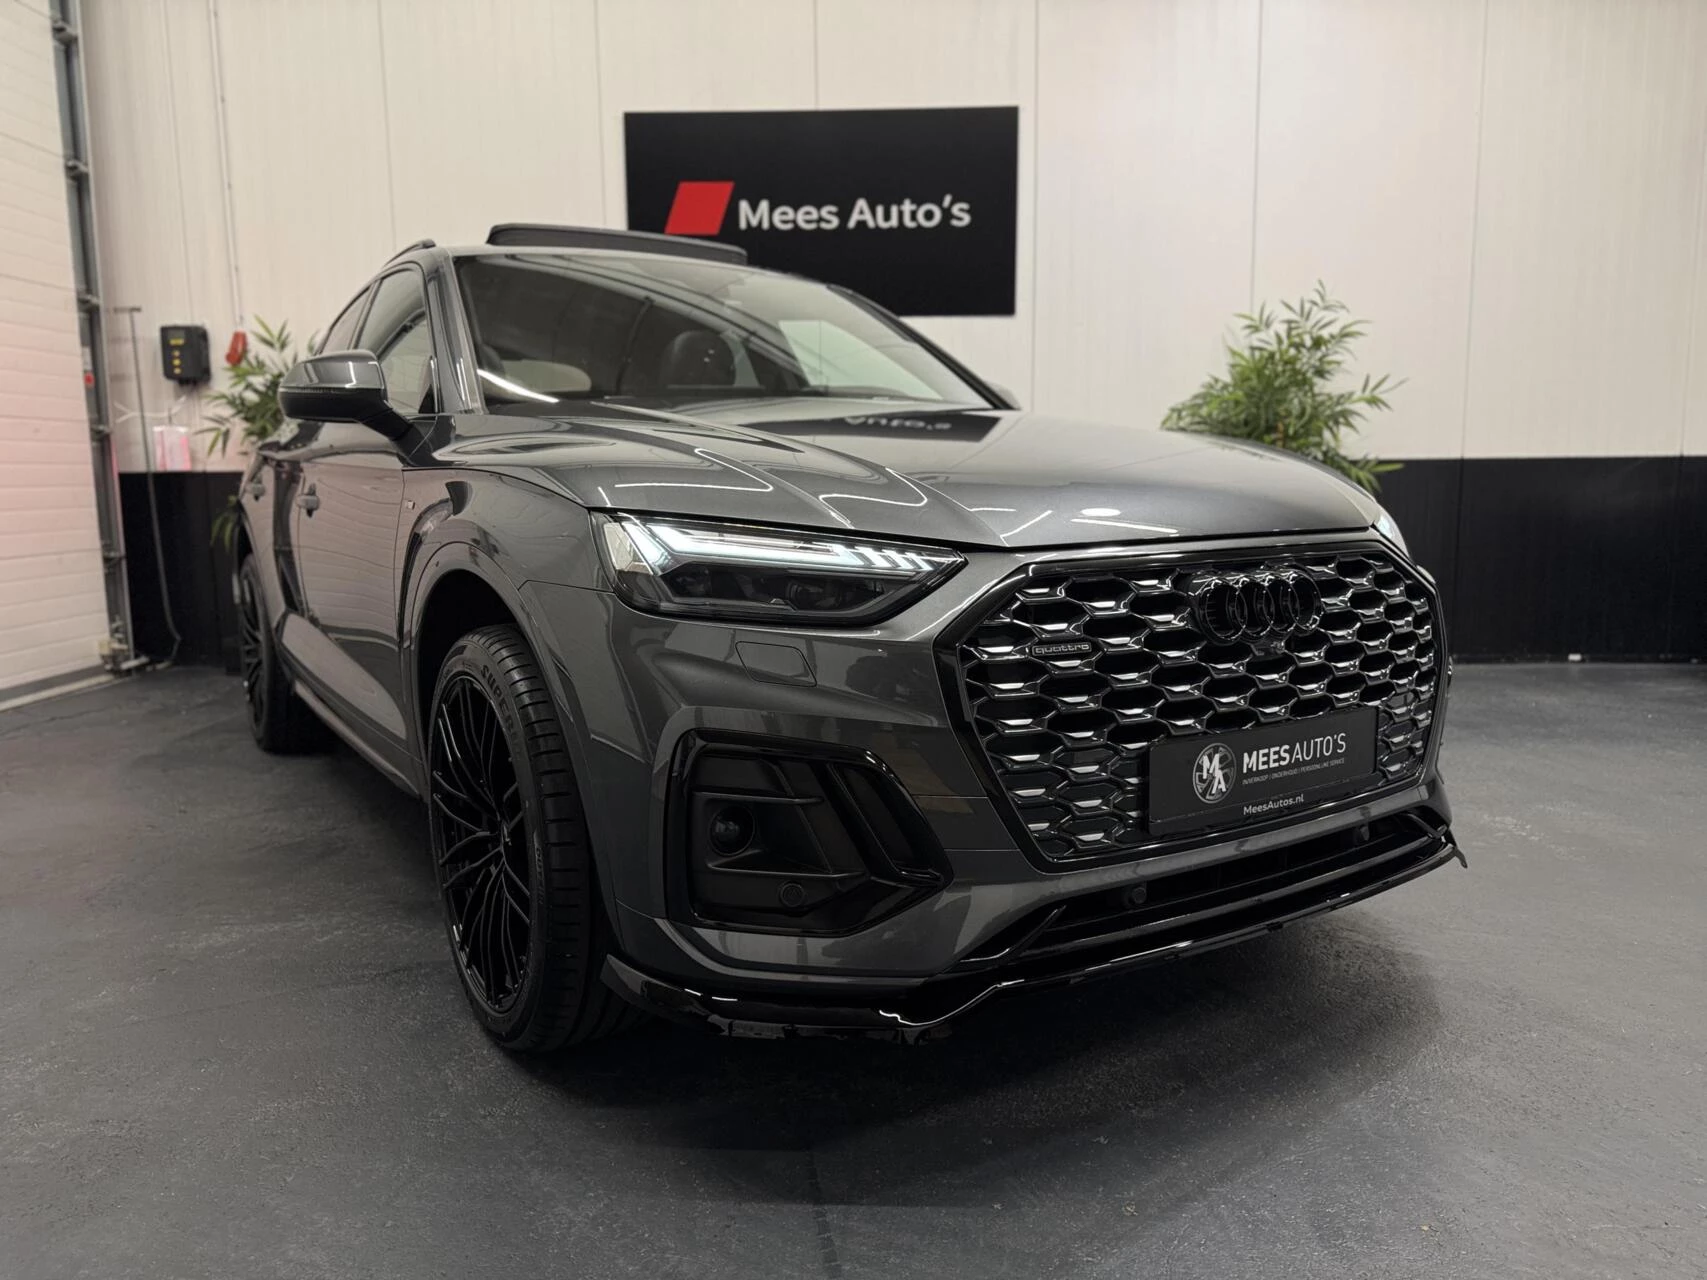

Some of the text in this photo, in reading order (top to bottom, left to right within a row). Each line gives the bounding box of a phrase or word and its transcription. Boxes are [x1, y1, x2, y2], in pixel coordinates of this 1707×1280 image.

[738, 194, 971, 230] Mees Auto's
[1035, 644, 1090, 654] quattro
[1243, 793, 1304, 815] MeesAutos.nl
